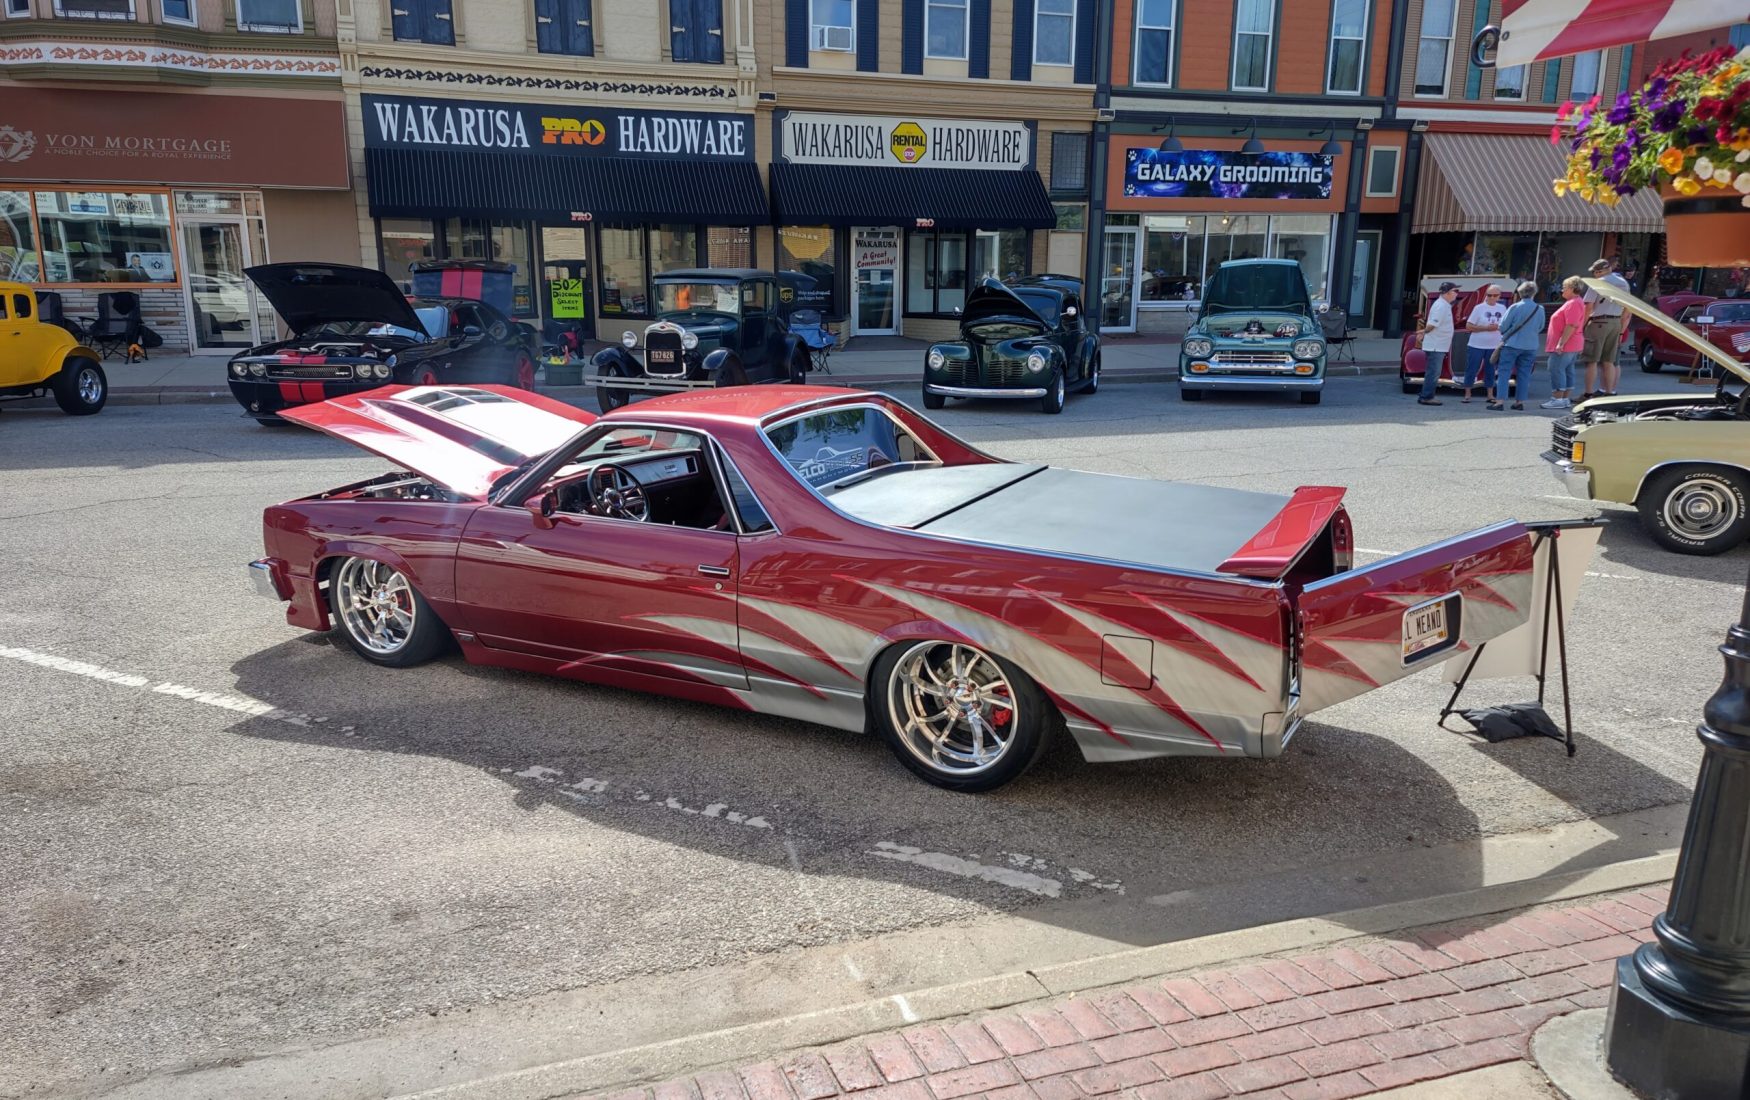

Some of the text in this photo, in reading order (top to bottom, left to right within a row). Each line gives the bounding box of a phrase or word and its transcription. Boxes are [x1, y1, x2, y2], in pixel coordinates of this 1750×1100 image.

[373, 102, 746, 156] WAKARUSA PRO HARDWARE
[46, 134, 231, 152] VON MORTGAGE
[792, 122, 1022, 163] WAKARUSA HARDWARE
[892, 135, 925, 147] RENTAL
[183, 153, 232, 161] EXPERIENCE
[1137, 163, 1323, 183] GALAXY GROOMING
[571, 211, 593, 221] PRO
[916, 218, 935, 227] PRO
[855, 240, 897, 248] WAKARUSA
[862, 250, 887, 260] A Great
[857, 256, 896, 268] Community!
[552, 279, 581, 290] 50%
[1684, 472, 1746, 519] COOPER COBRA
[1667, 529, 1706, 546] RADIAL
